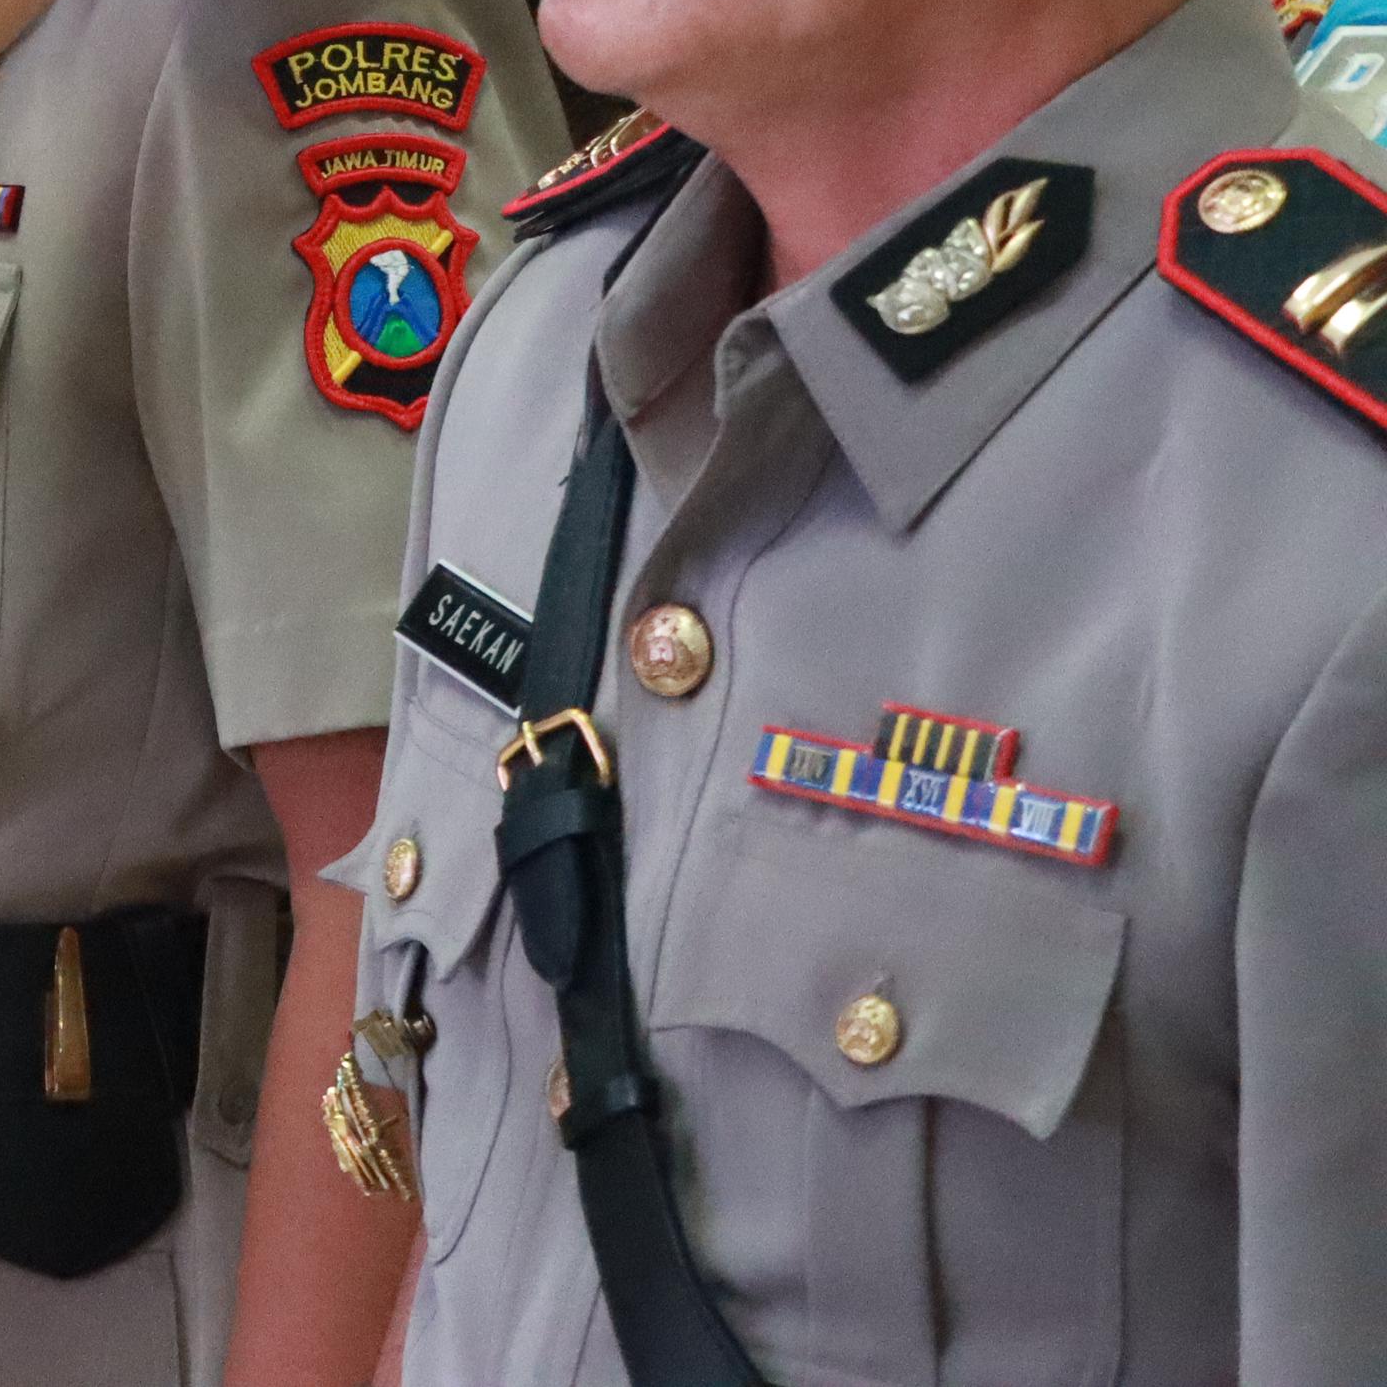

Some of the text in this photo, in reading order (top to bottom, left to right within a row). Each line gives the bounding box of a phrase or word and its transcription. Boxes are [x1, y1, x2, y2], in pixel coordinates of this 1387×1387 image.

[288, 41, 458, 85] POLRES
[295, 71, 454, 109] JOMBANG
[321, 149, 446, 179] JAWA TIMUR
[428, 593, 524, 674] SAEKAN
